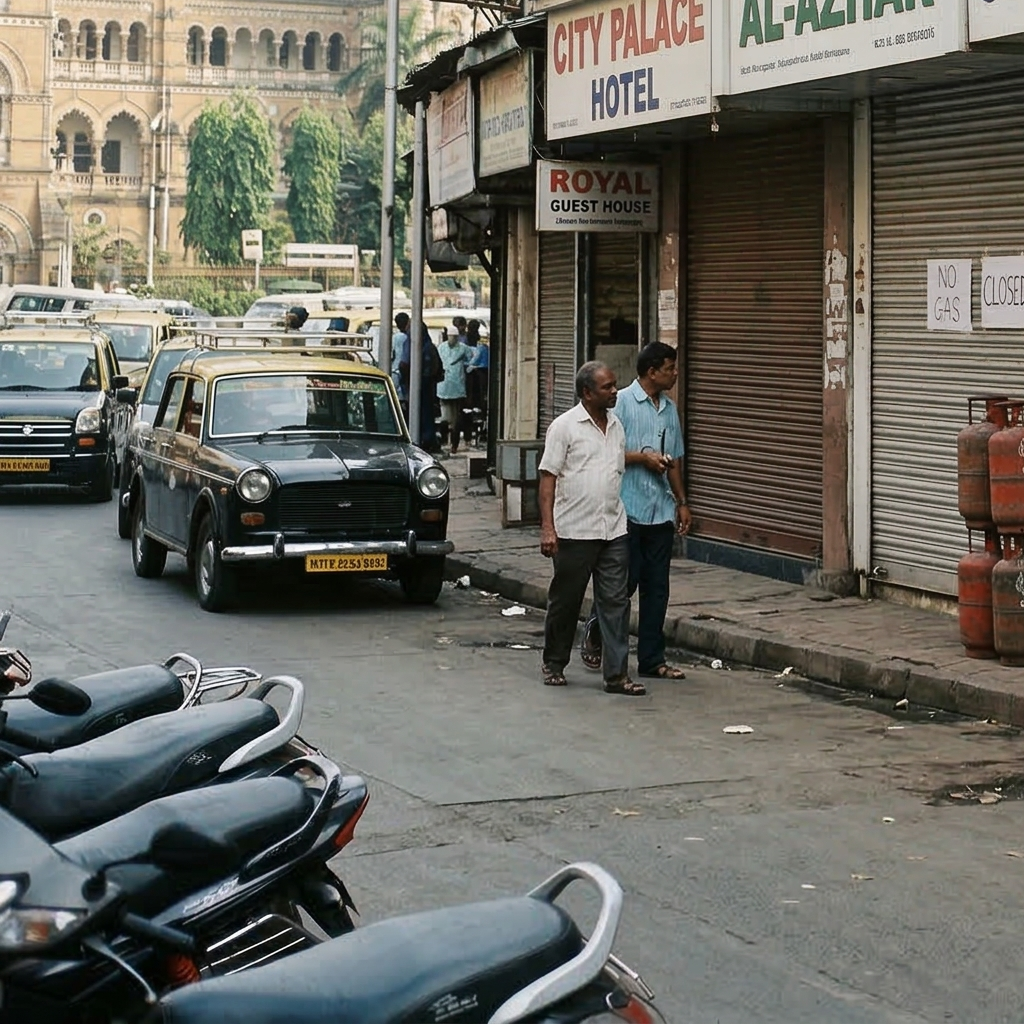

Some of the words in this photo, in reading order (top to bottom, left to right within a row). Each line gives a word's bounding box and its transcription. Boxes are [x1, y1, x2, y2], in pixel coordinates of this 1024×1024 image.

[553, 12, 604, 75] CITY
[591, 67, 660, 121] HOTEL
[550, 169, 652, 195] ROYAL
[550, 199, 598, 213] GUEST
[603, 200, 651, 213] HOUSE
[938, 264, 957, 288] NO
[934, 296, 960, 322] GAS
